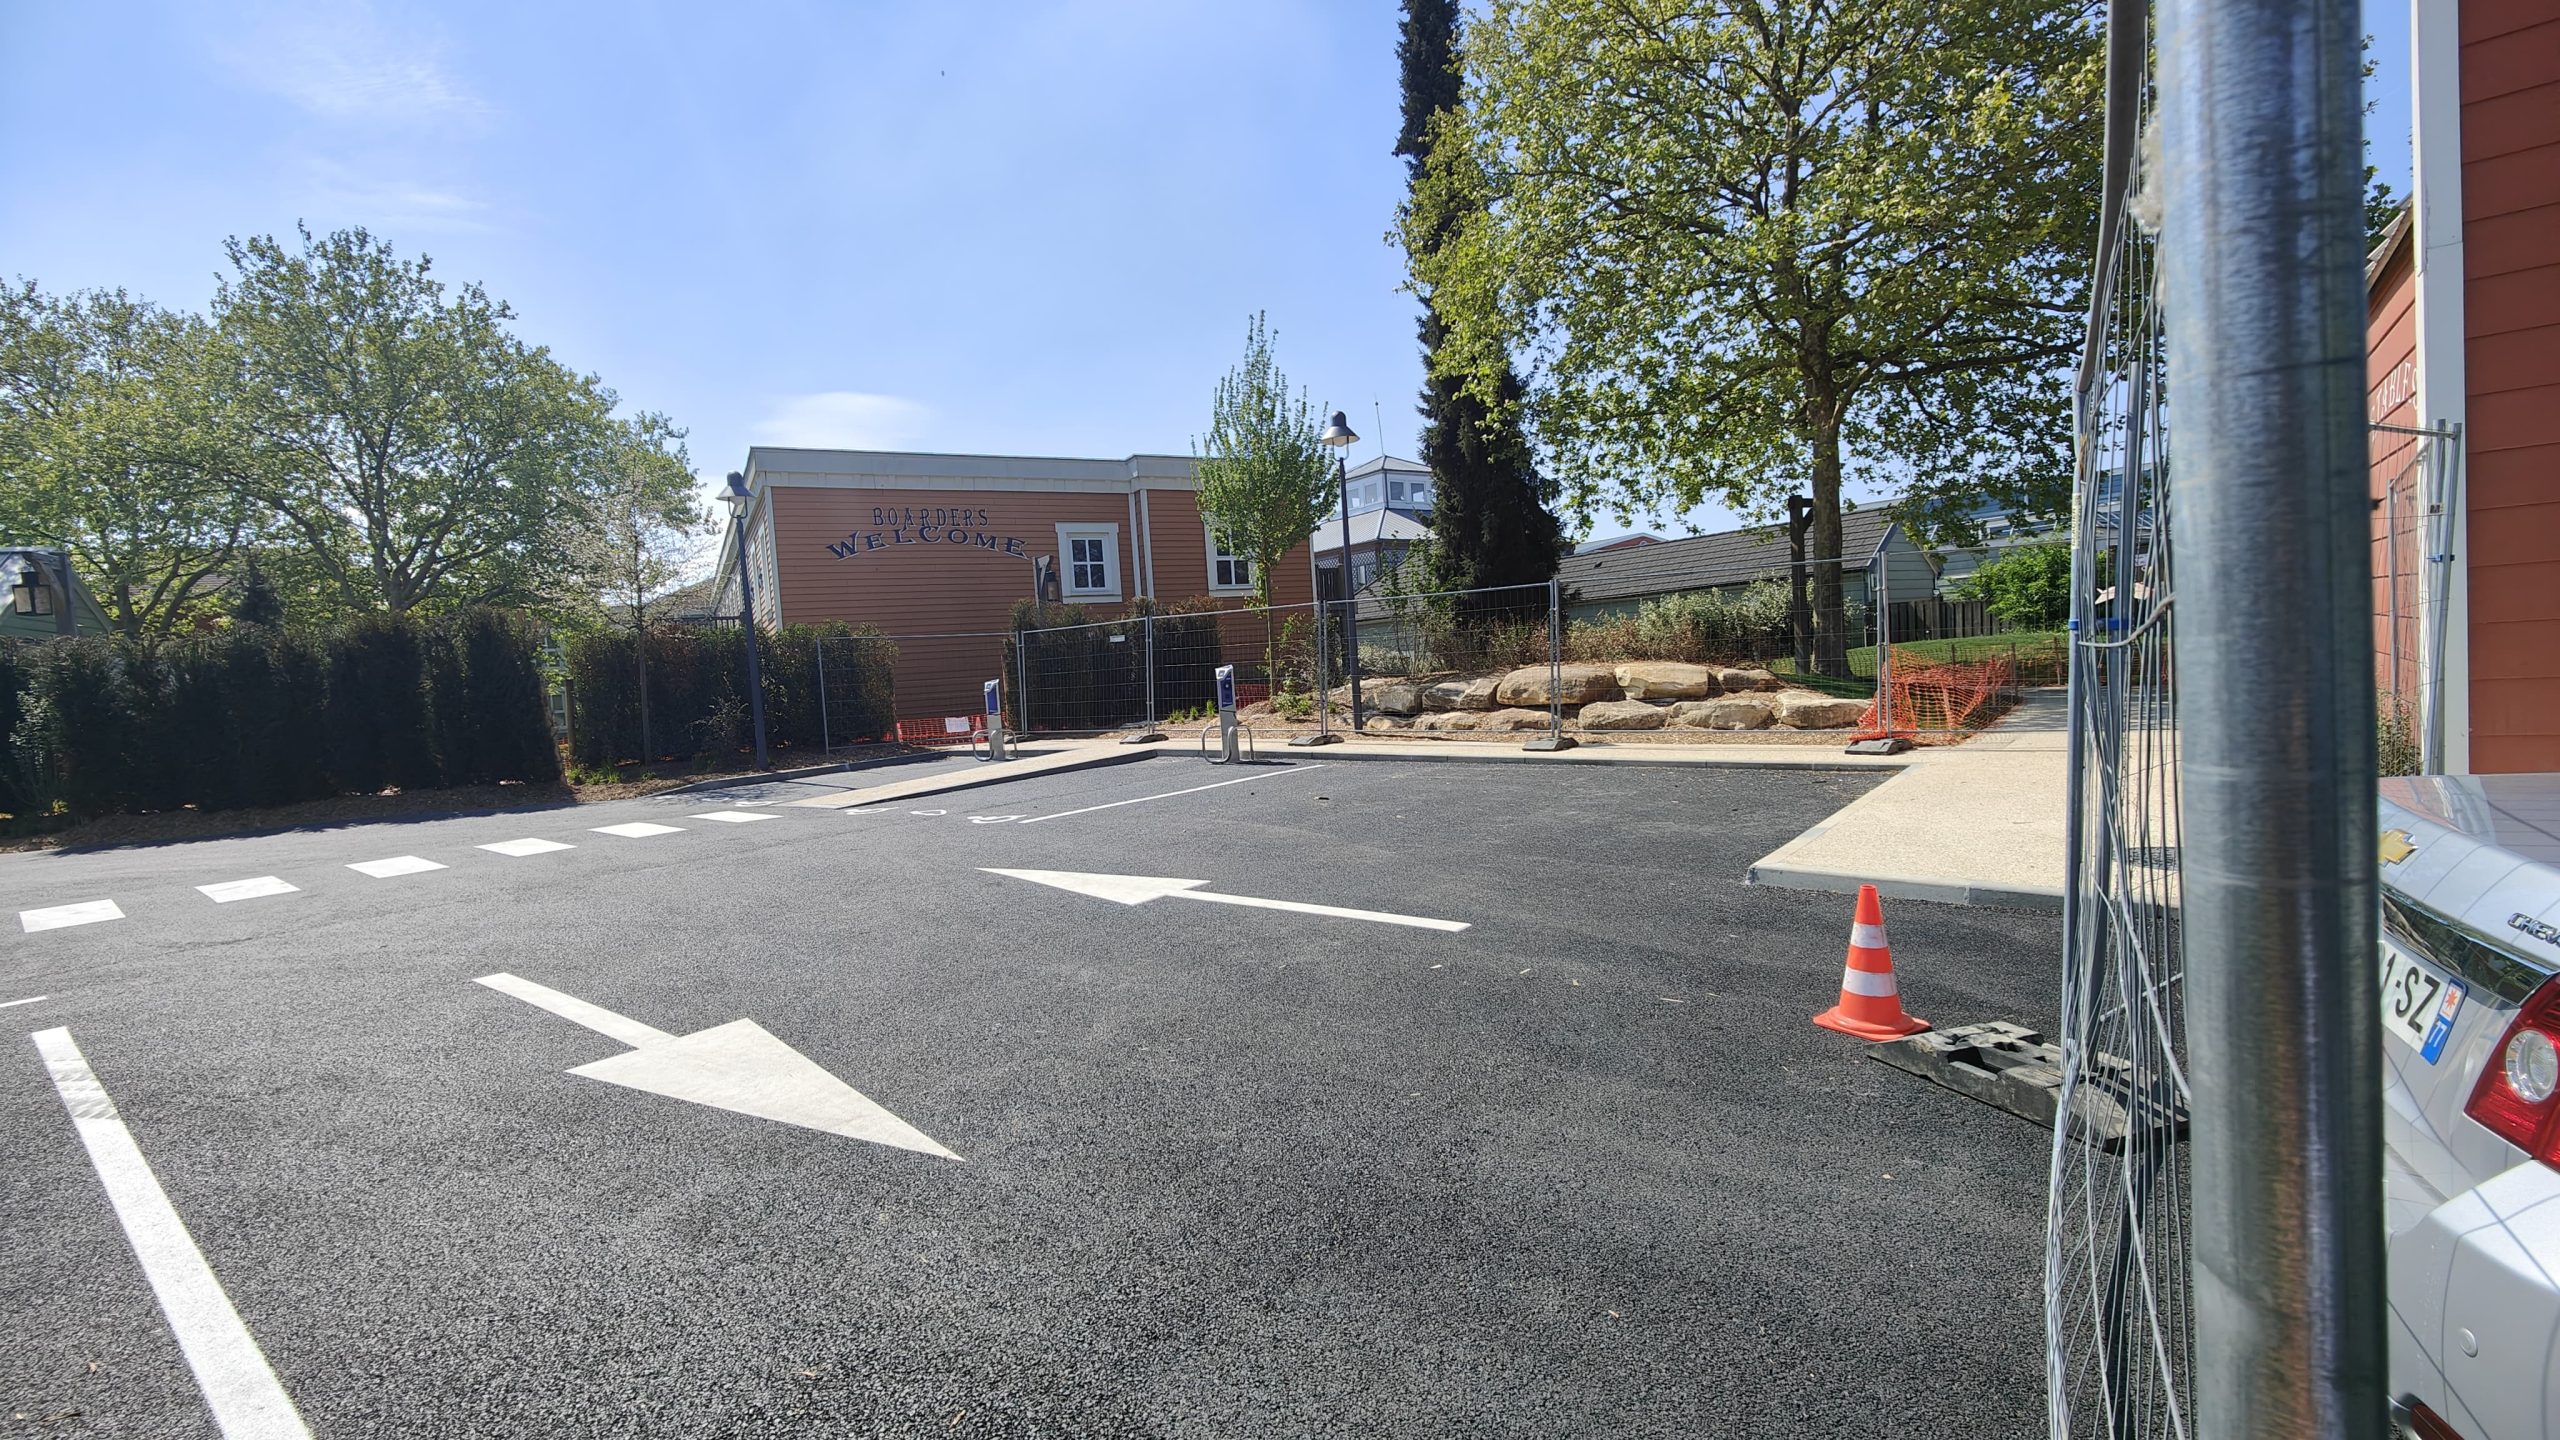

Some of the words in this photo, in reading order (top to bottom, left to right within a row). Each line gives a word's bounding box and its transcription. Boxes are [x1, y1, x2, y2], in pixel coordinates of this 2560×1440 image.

[2369, 362, 2417, 434] TABLES
[872, 506, 990, 528] BOARDERS
[826, 524, 1029, 561] WELCOME
[2507, 912, 2560, 947] CHEV
[2380, 948, 2441, 1035] 1-SZ
[2428, 1020, 2448, 1048] 77
